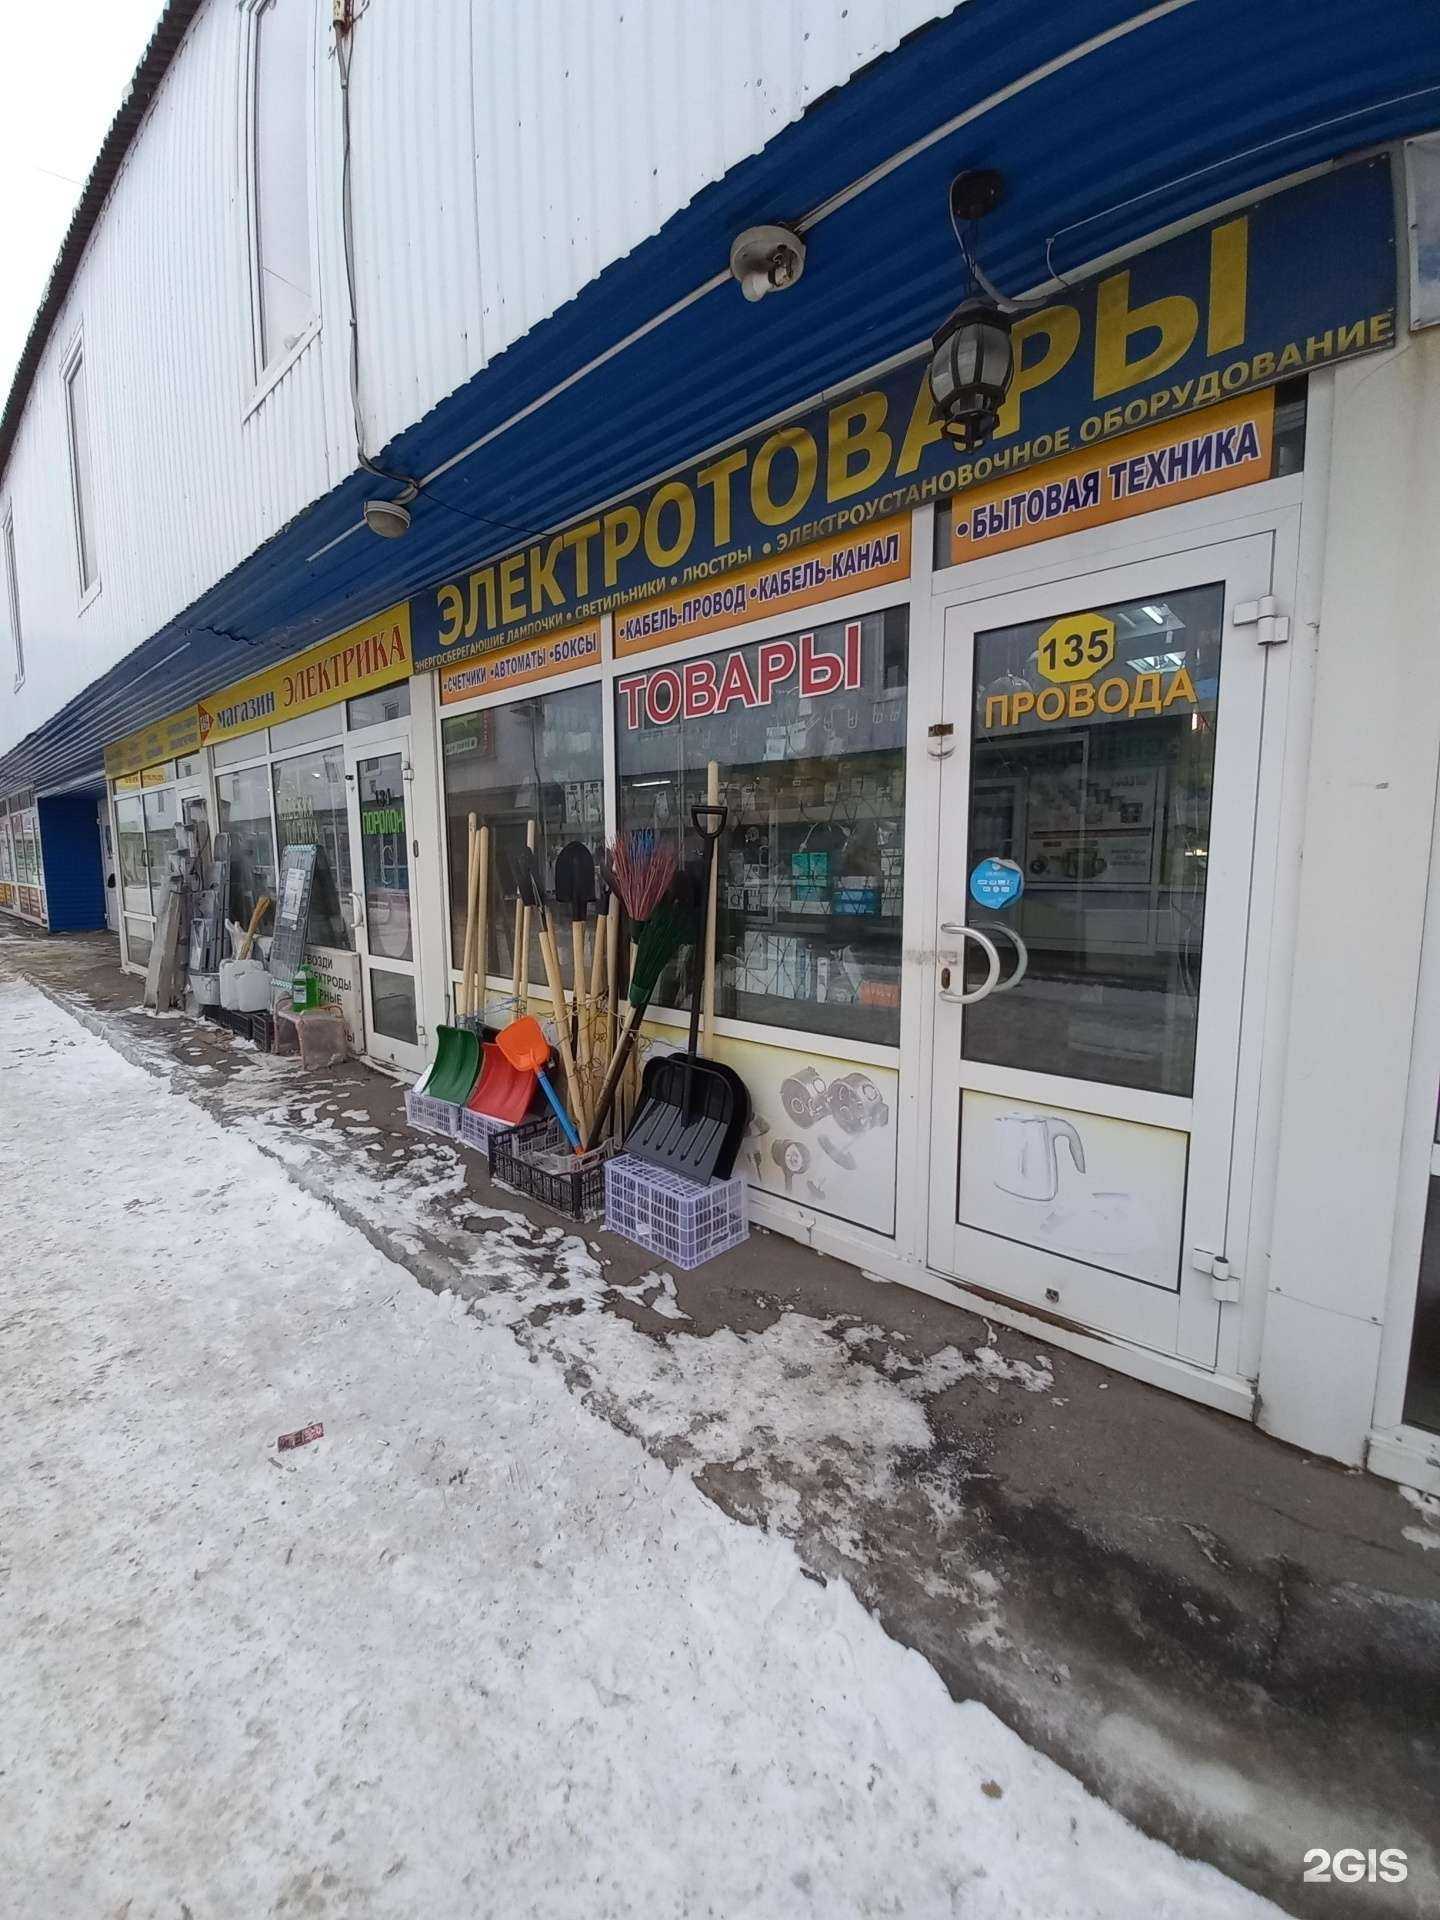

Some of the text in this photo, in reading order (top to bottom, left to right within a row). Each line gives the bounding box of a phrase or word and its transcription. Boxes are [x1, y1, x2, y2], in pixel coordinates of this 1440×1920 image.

[415, 311, 1393, 673] ЭНЕРГОСБЕРЕГАЮЩИЕ ЛАМПОЧКИ СВЕТИЛЬНИКИ ЛЮСТРЫ ЭЛЕКТРОУСТАНОВОЧНОЕ ОБОРУДОВАНИЕ
[971, 421, 1260, 541] БЫТОВАЯ ТЕХНИКА
[625, 533, 900, 641] КАБЕЛЬ-ПРОВОД КАБЕЛЬ-КАНАЛ
[216, 624, 406, 728] магазин ЭЛЕКТРИКА
[447, 633, 597, 693] СЧЕТЧИКИ АВТОМАТЫ БОКСЫ
[619, 622, 862, 730] ТОВАРЫ
[984, 667, 1199, 730] ПРОВОДА
[1042, 629, 1108, 671] 135
[362, 808, 405, 835] ПОРОЛОН
